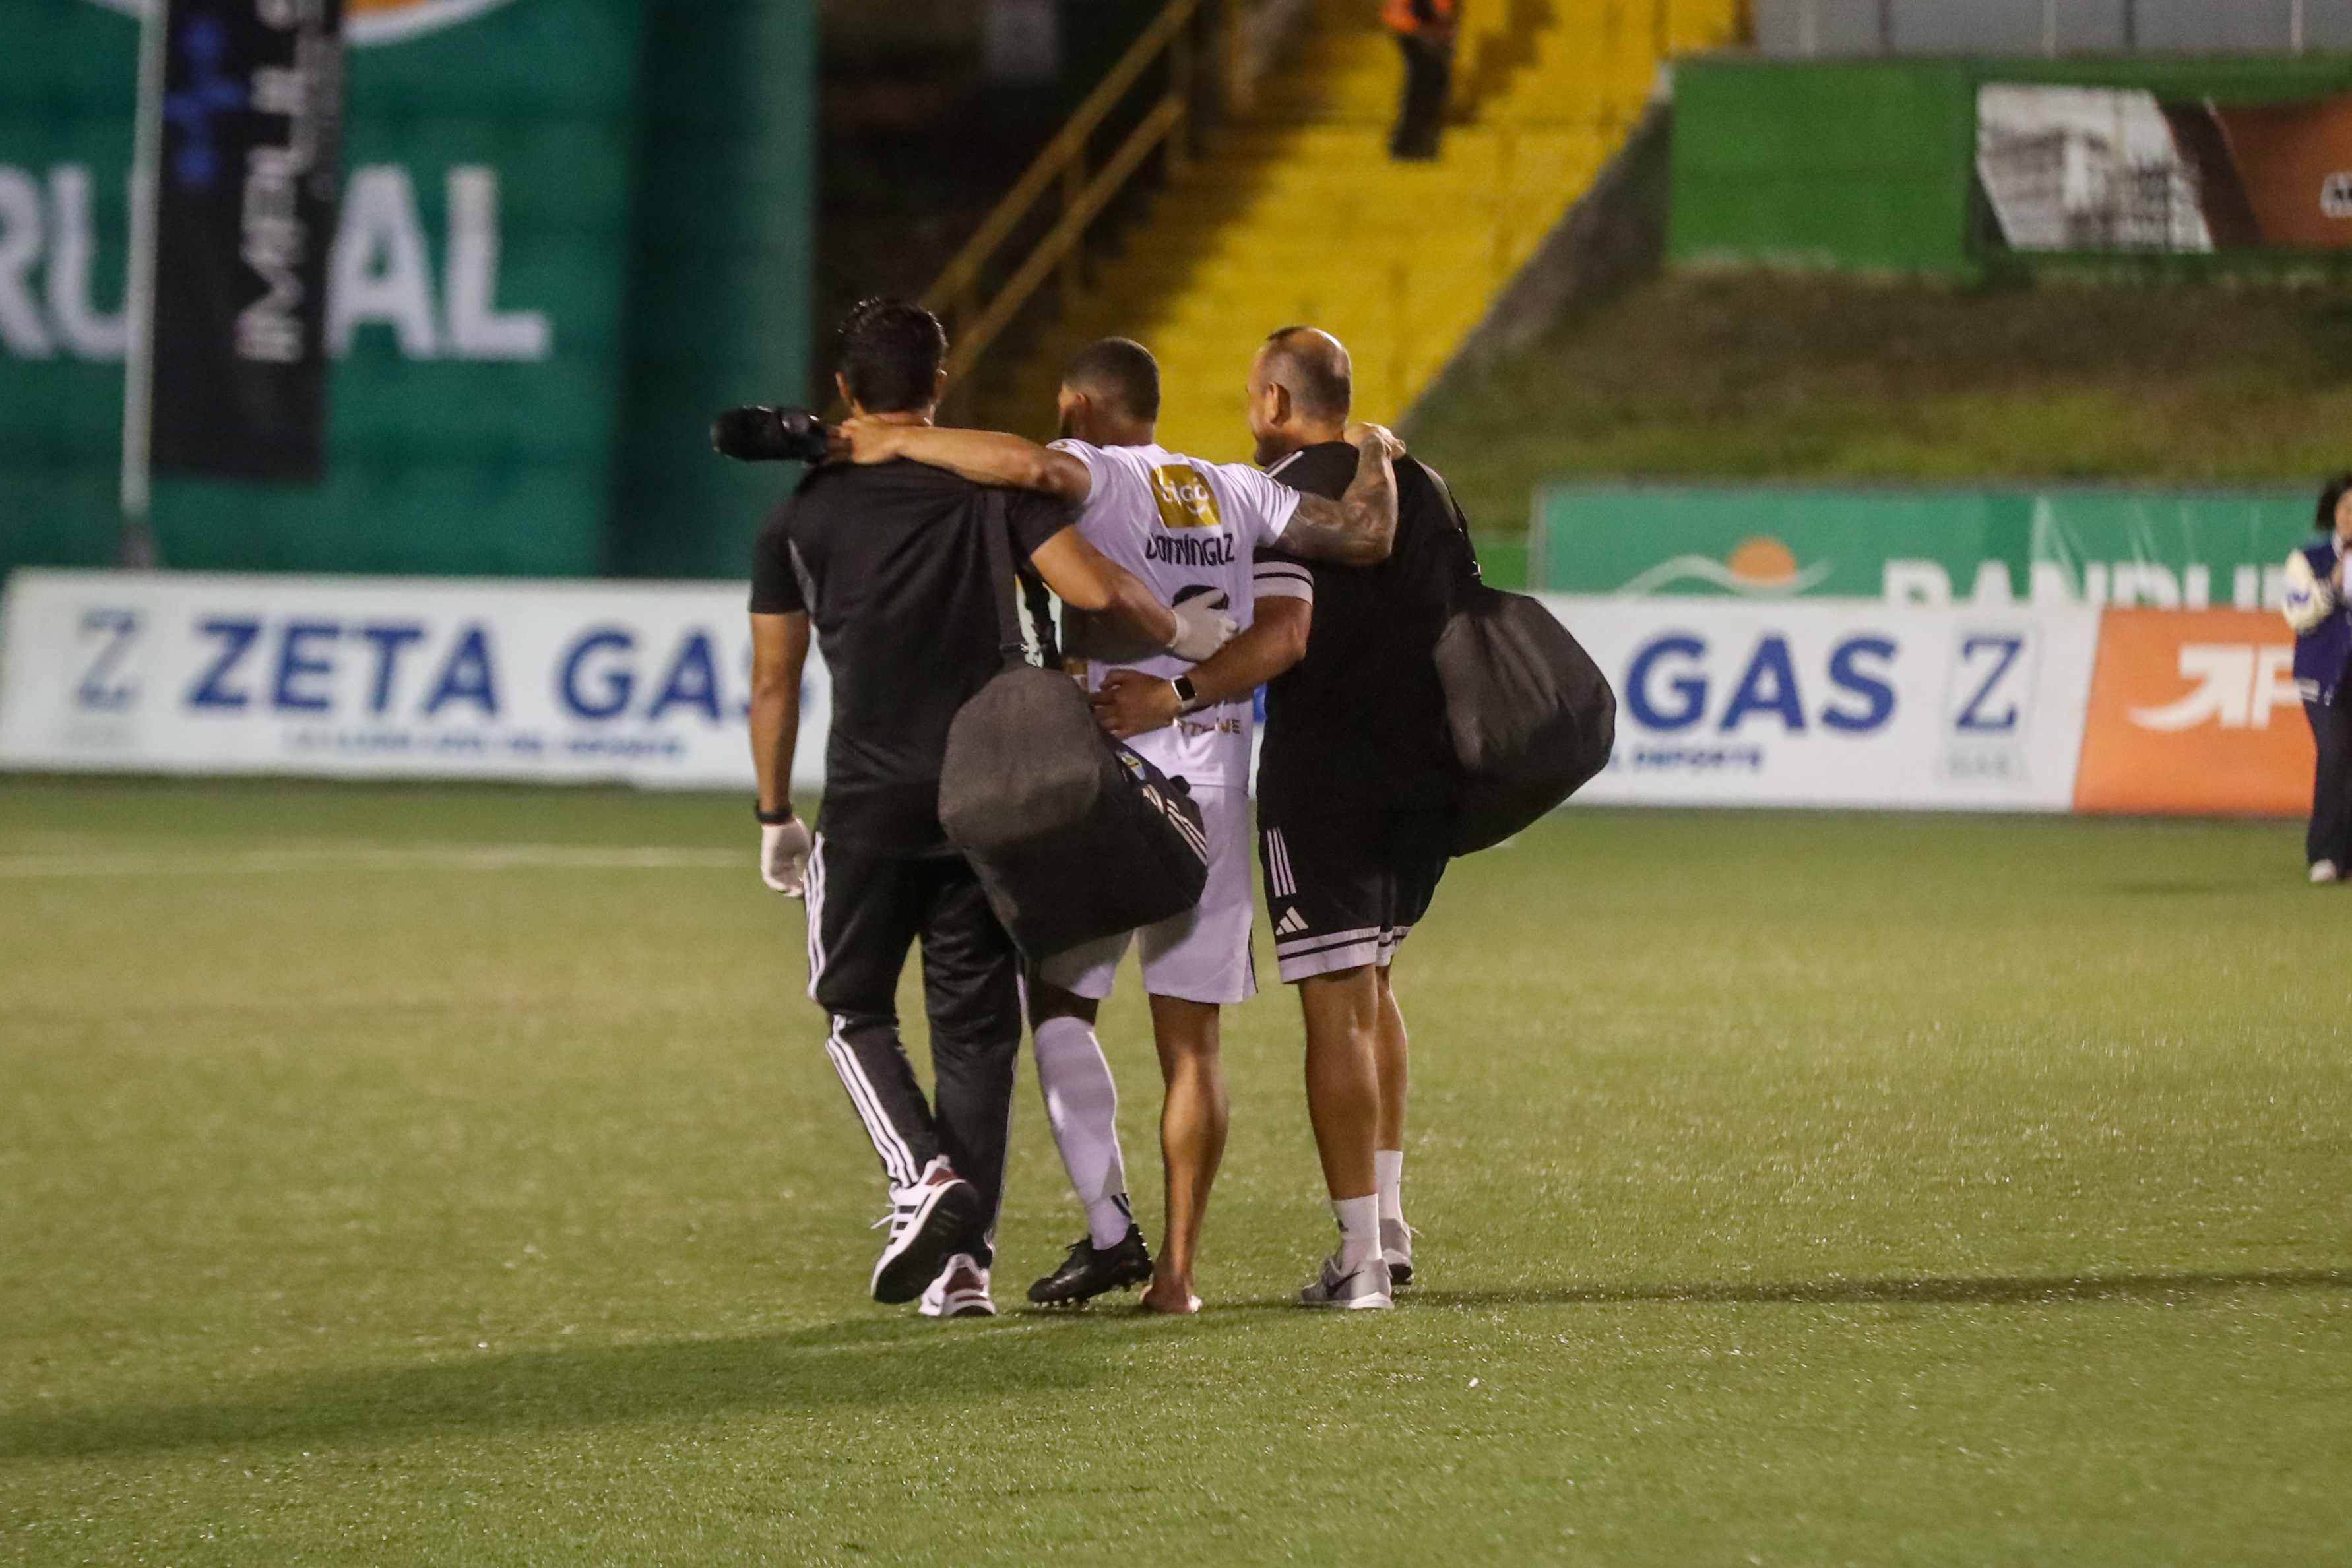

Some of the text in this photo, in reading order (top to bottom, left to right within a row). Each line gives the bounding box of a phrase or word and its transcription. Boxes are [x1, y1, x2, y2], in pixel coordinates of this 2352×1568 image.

[0, 164, 550, 360] RUAL
[187, 617, 813, 723] ZETA GA
[1624, 633, 1900, 734] GAS
[1954, 636, 2025, 731] Z
